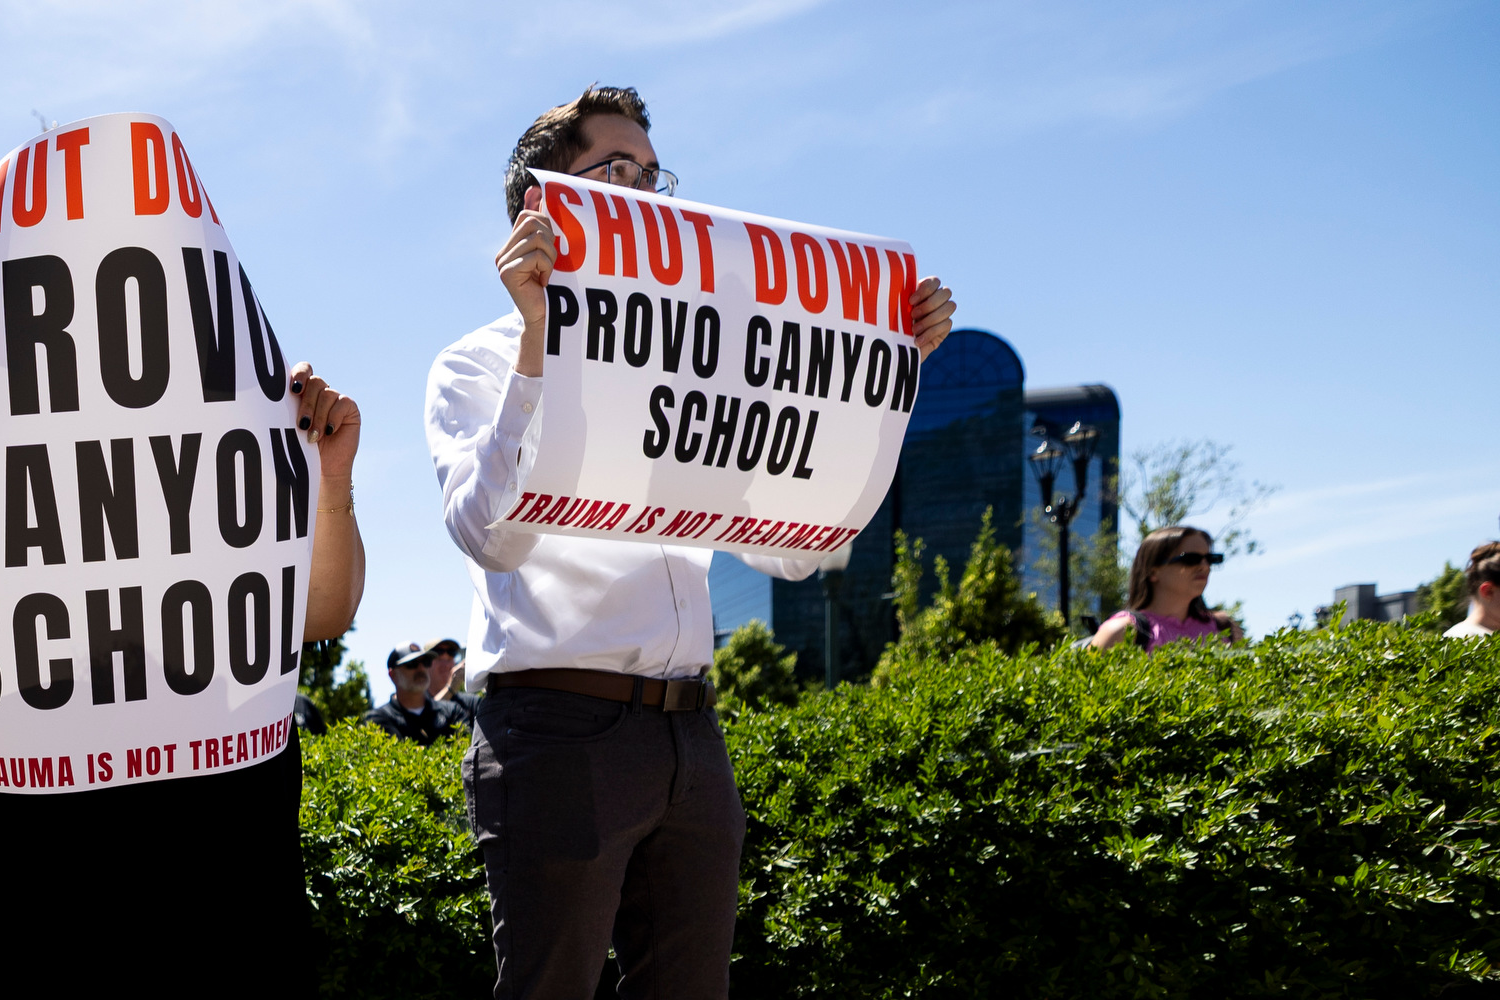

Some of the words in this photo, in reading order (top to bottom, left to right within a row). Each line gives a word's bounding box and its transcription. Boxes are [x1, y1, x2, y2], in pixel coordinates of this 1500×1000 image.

[130, 121, 224, 230] DO
[543, 181, 716, 294] SHUT
[742, 222, 916, 337] DOWN
[546, 284, 721, 379] PROVO
[743, 314, 921, 413] CANYON
[642, 385, 820, 480] SCHOOL
[506, 492, 631, 531] TRAUMA
[629, 505, 667, 534] IS
[658, 509, 721, 540] NOT
[715, 515, 860, 553] TREATMENT
[86, 751, 114, 784] IS
[126, 743, 177, 779] NOT
